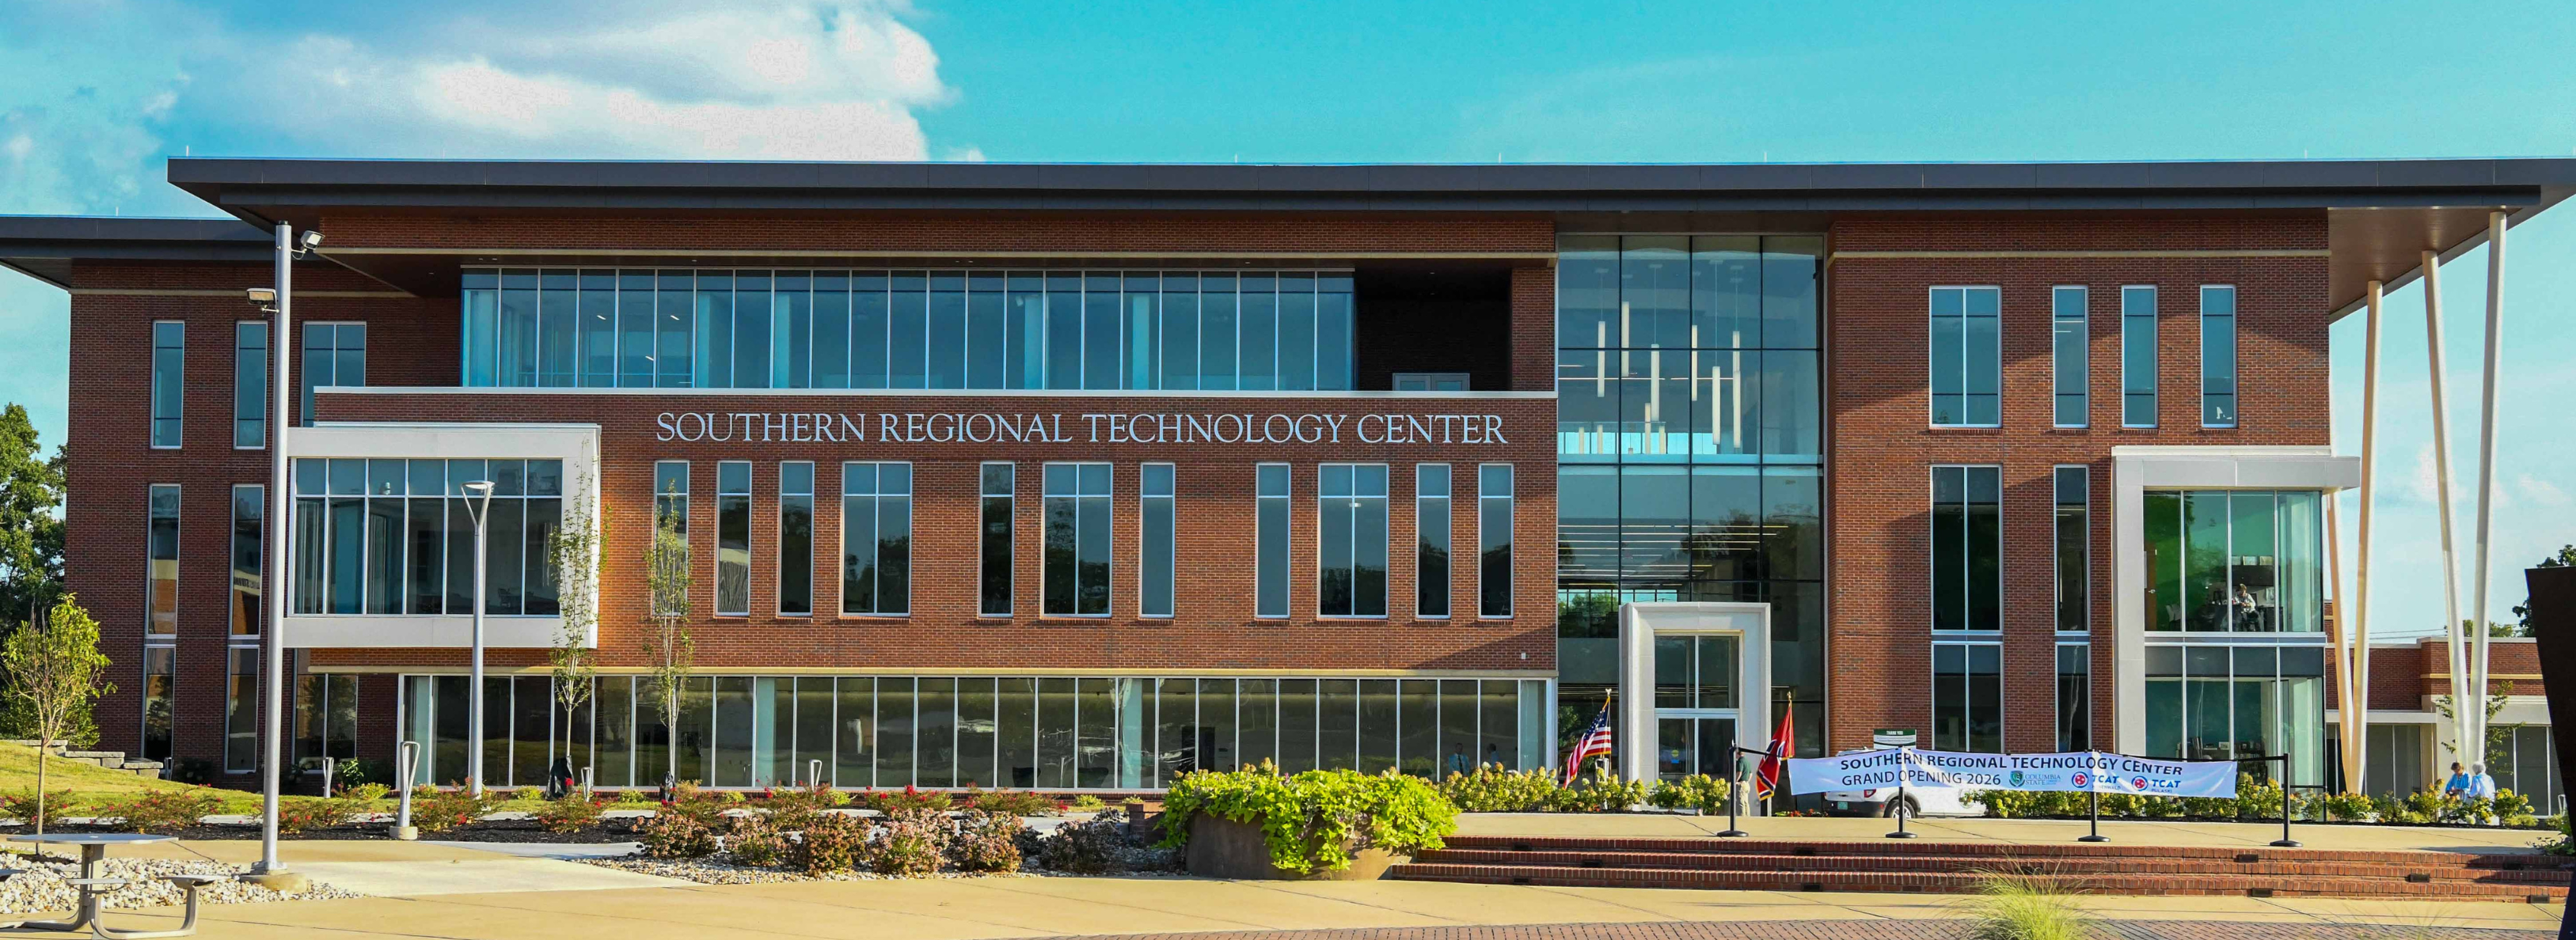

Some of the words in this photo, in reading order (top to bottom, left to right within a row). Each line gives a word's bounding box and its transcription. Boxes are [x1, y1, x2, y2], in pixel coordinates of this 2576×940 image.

[656, 412, 865, 442] SOUTHERN
[879, 413, 1073, 442] REGIONAL
[1081, 413, 1347, 443] TECHNOLOGY
[1357, 414, 1508, 443] CENTER
[1841, 752, 1923, 770] SOUTHERN
[1927, 755, 2008, 768] REGIONAL
[2011, 756, 2118, 770] TECHNOLOGY
[2122, 759, 2183, 775] CENTER
[1841, 771, 1894, 786] GRAND
[1898, 770, 1962, 783] OPENING
[1966, 773, 2001, 785] 2026
[2092, 775, 2119, 783] TCAT
[2152, 779, 2181, 788] TCAT
